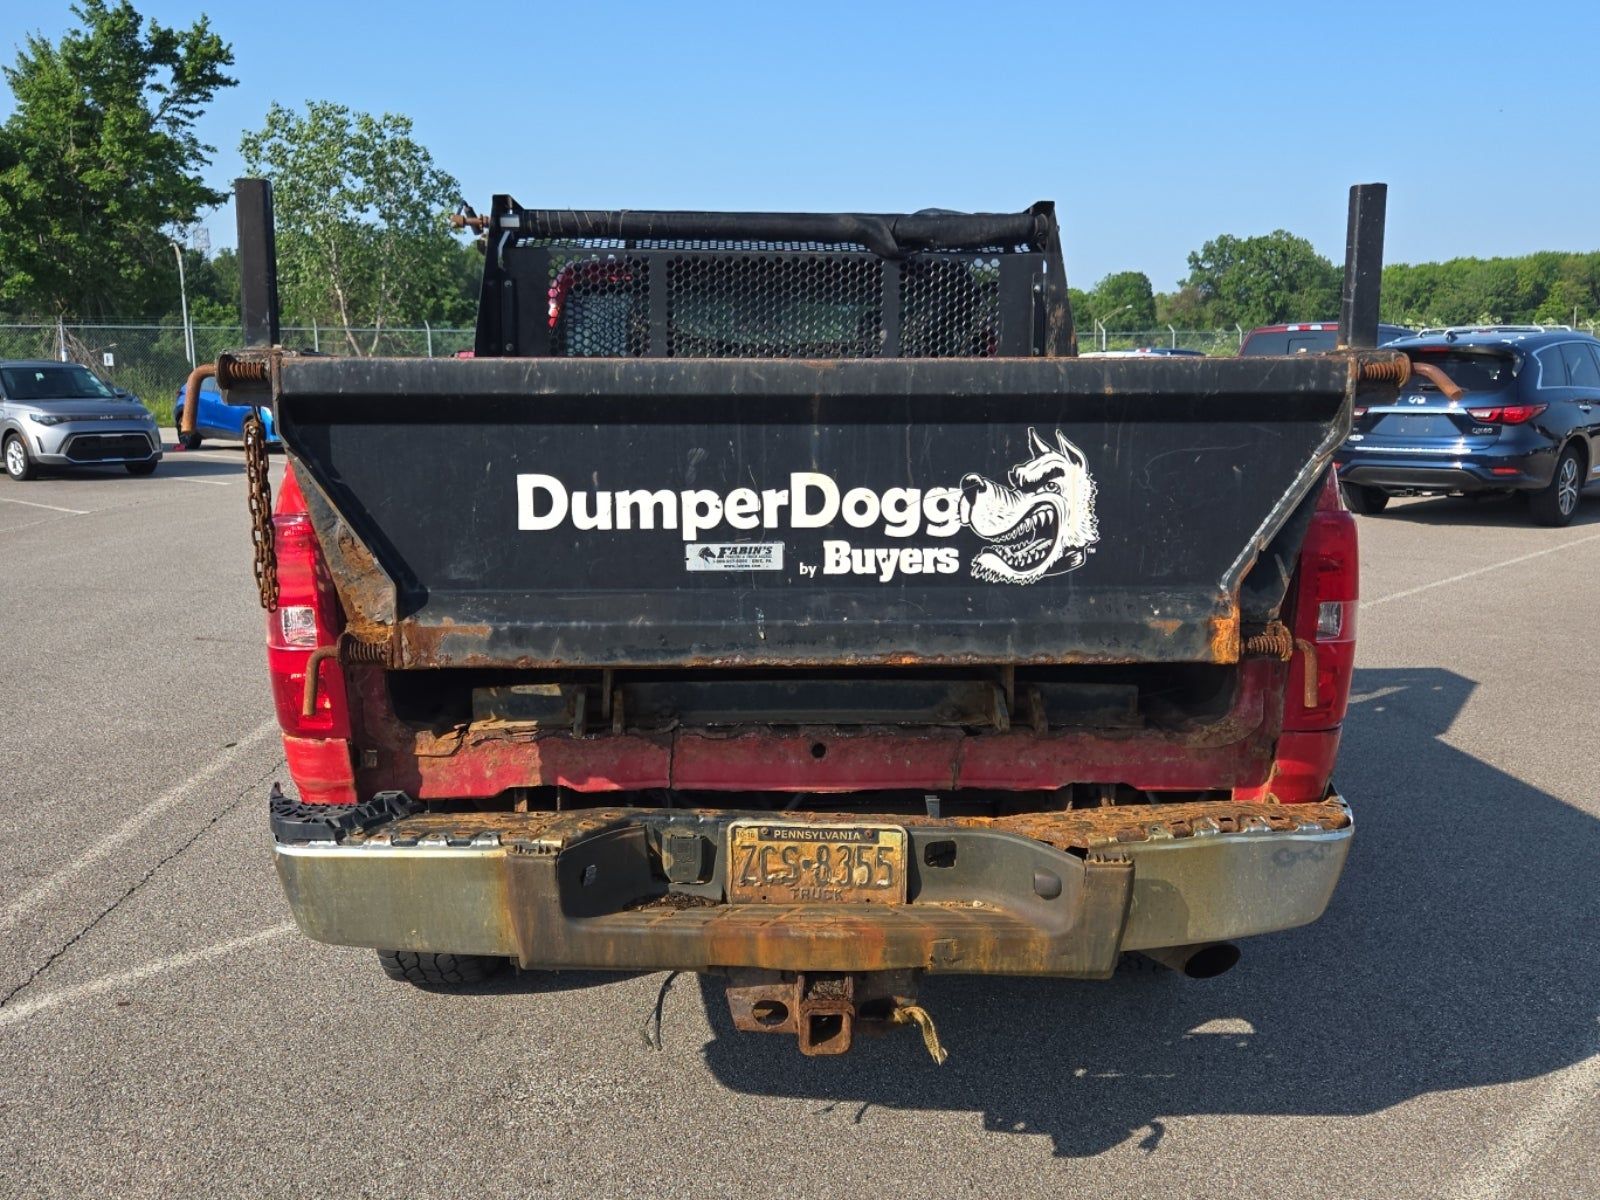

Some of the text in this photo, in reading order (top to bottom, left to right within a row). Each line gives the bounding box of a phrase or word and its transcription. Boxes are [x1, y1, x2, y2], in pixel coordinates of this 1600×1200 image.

[516, 473, 963, 540] DumperDogg
[717, 546, 773, 558] FABIN'S
[799, 540, 960, 583] by Buyers
[773, 829, 861, 840] PENNSYLVANIA
[789, 888, 843, 900] TRUCK
